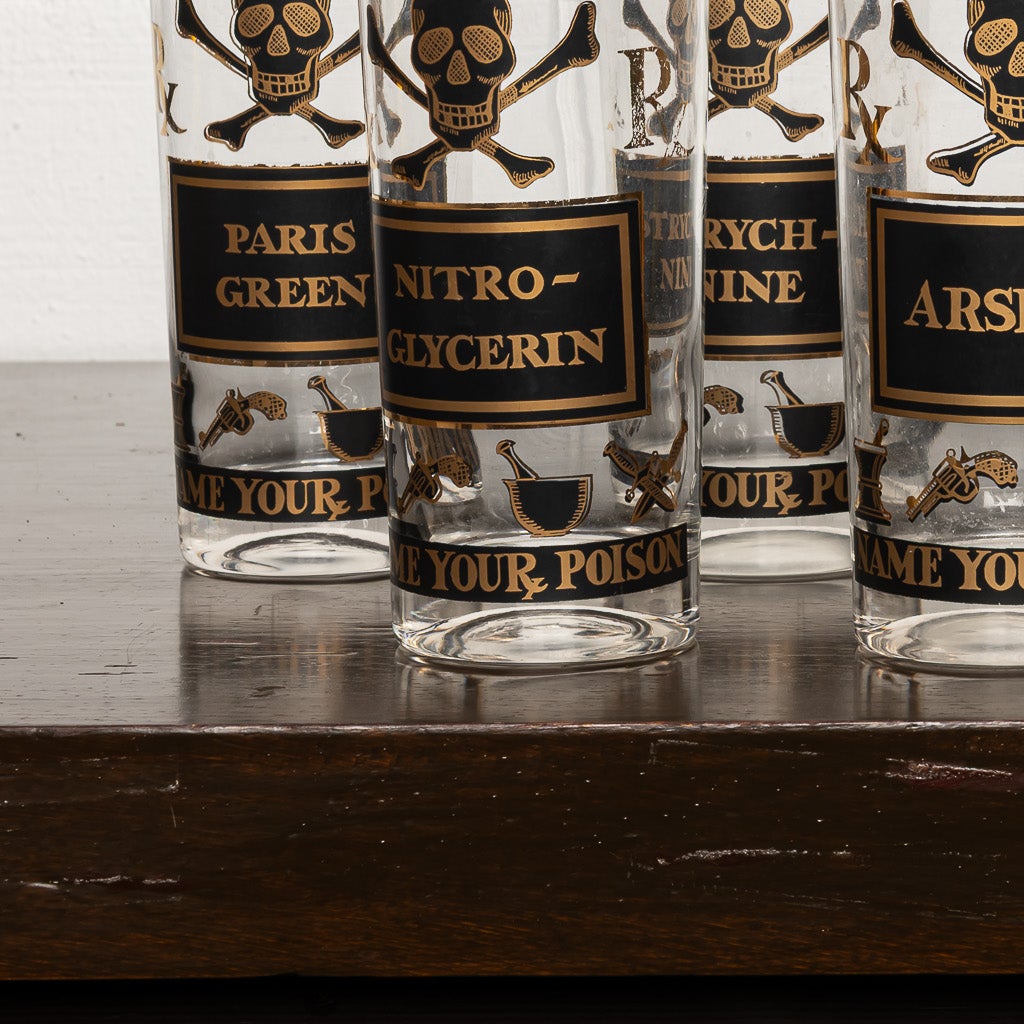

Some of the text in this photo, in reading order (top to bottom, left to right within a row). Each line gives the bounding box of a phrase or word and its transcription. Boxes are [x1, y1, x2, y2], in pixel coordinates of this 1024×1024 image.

[223, 219, 356, 255] PARIS
[216, 274, 370, 308] GREEN
[387, 327, 607, 372] GLYCERIN
[554, 528, 684, 590] POISON
[857, 532, 942, 588] NAME
